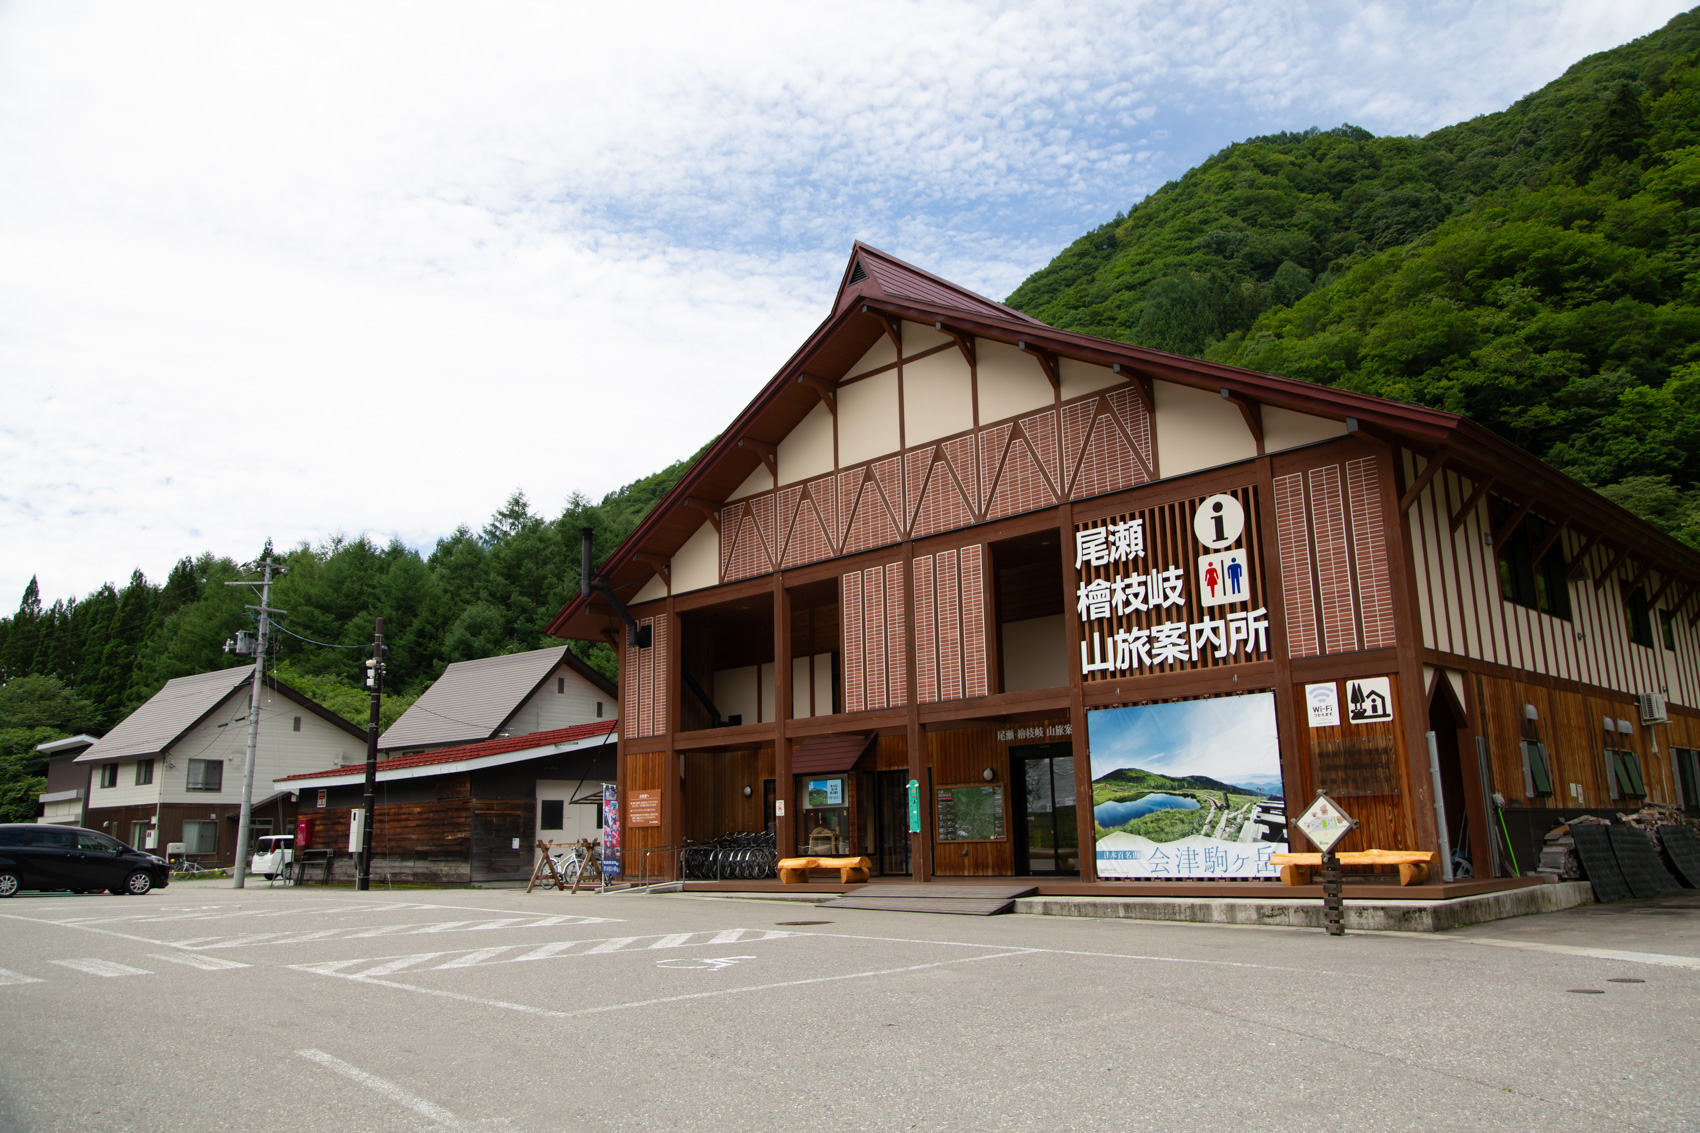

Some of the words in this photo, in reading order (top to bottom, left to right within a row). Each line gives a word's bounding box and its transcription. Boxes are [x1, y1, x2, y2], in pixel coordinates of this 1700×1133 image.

[1075, 518, 1146, 570] 尾瀬
[1076, 565, 1186, 622] 檜枝岐
[1080, 606, 1269, 675] 山旅案内所
[1312, 705, 1332, 713] Wi-Fi
[1103, 851, 1140, 859] 日本百名山
